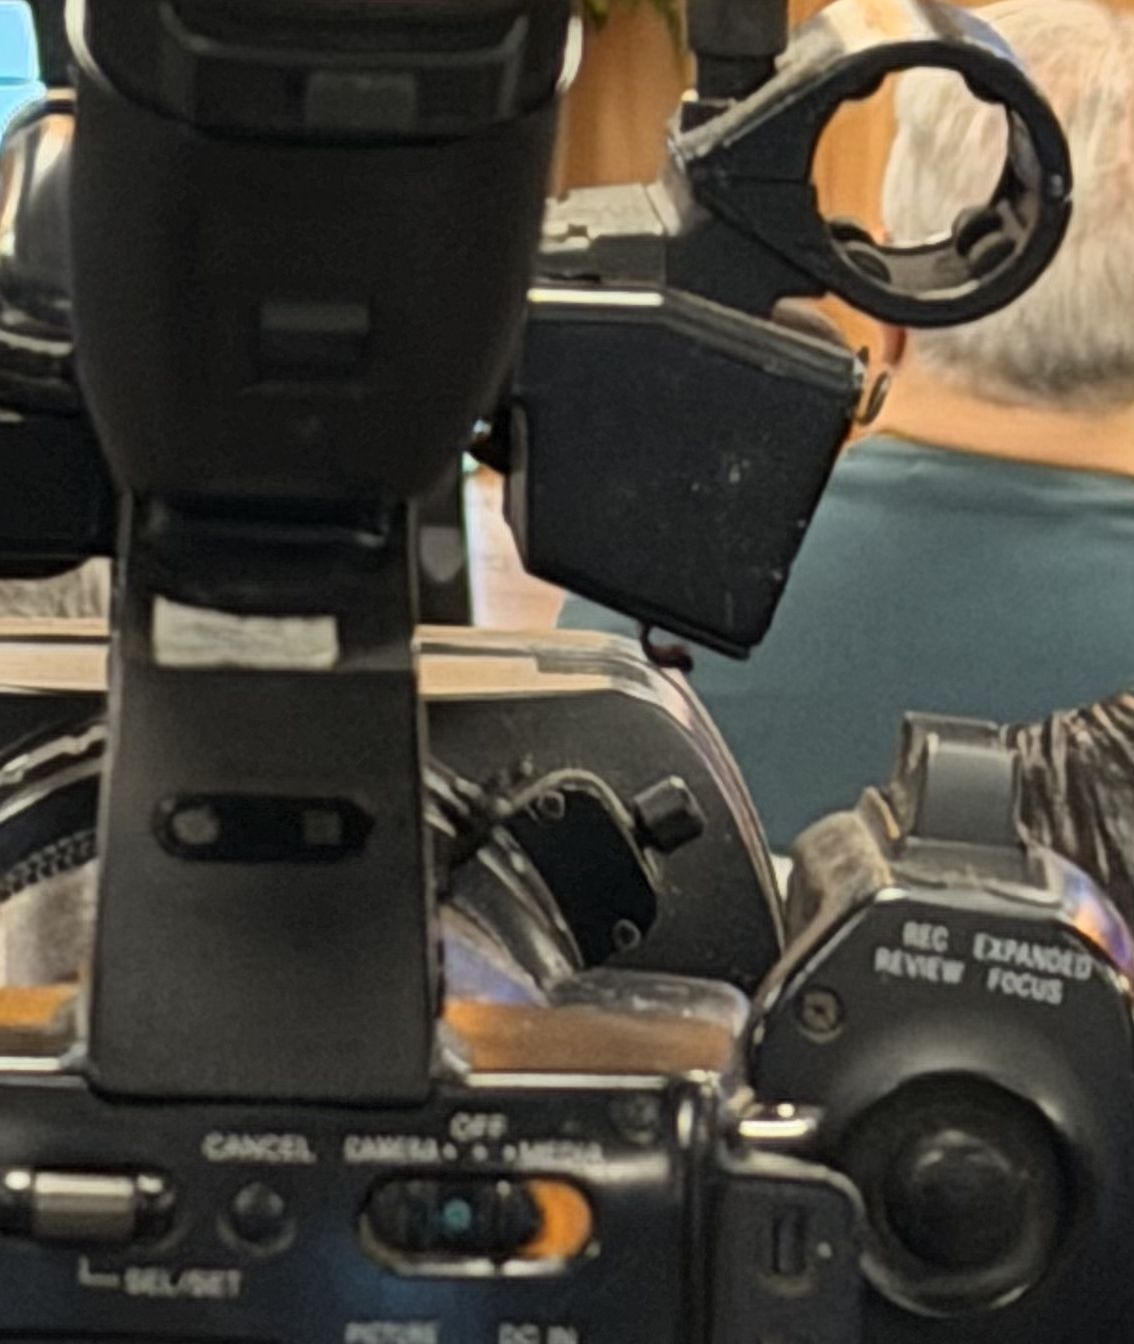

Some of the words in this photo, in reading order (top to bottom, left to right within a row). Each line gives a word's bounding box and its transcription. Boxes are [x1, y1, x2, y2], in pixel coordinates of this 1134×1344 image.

[902, 921, 949, 952] REC
[874, 947, 965, 984] REVIEW
[973, 932, 1092, 980] EXPANDED
[987, 967, 1064, 1005] FOCUS
[450, 1113, 507, 1142] OFF
[202, 1132, 317, 1163] CANCEL
